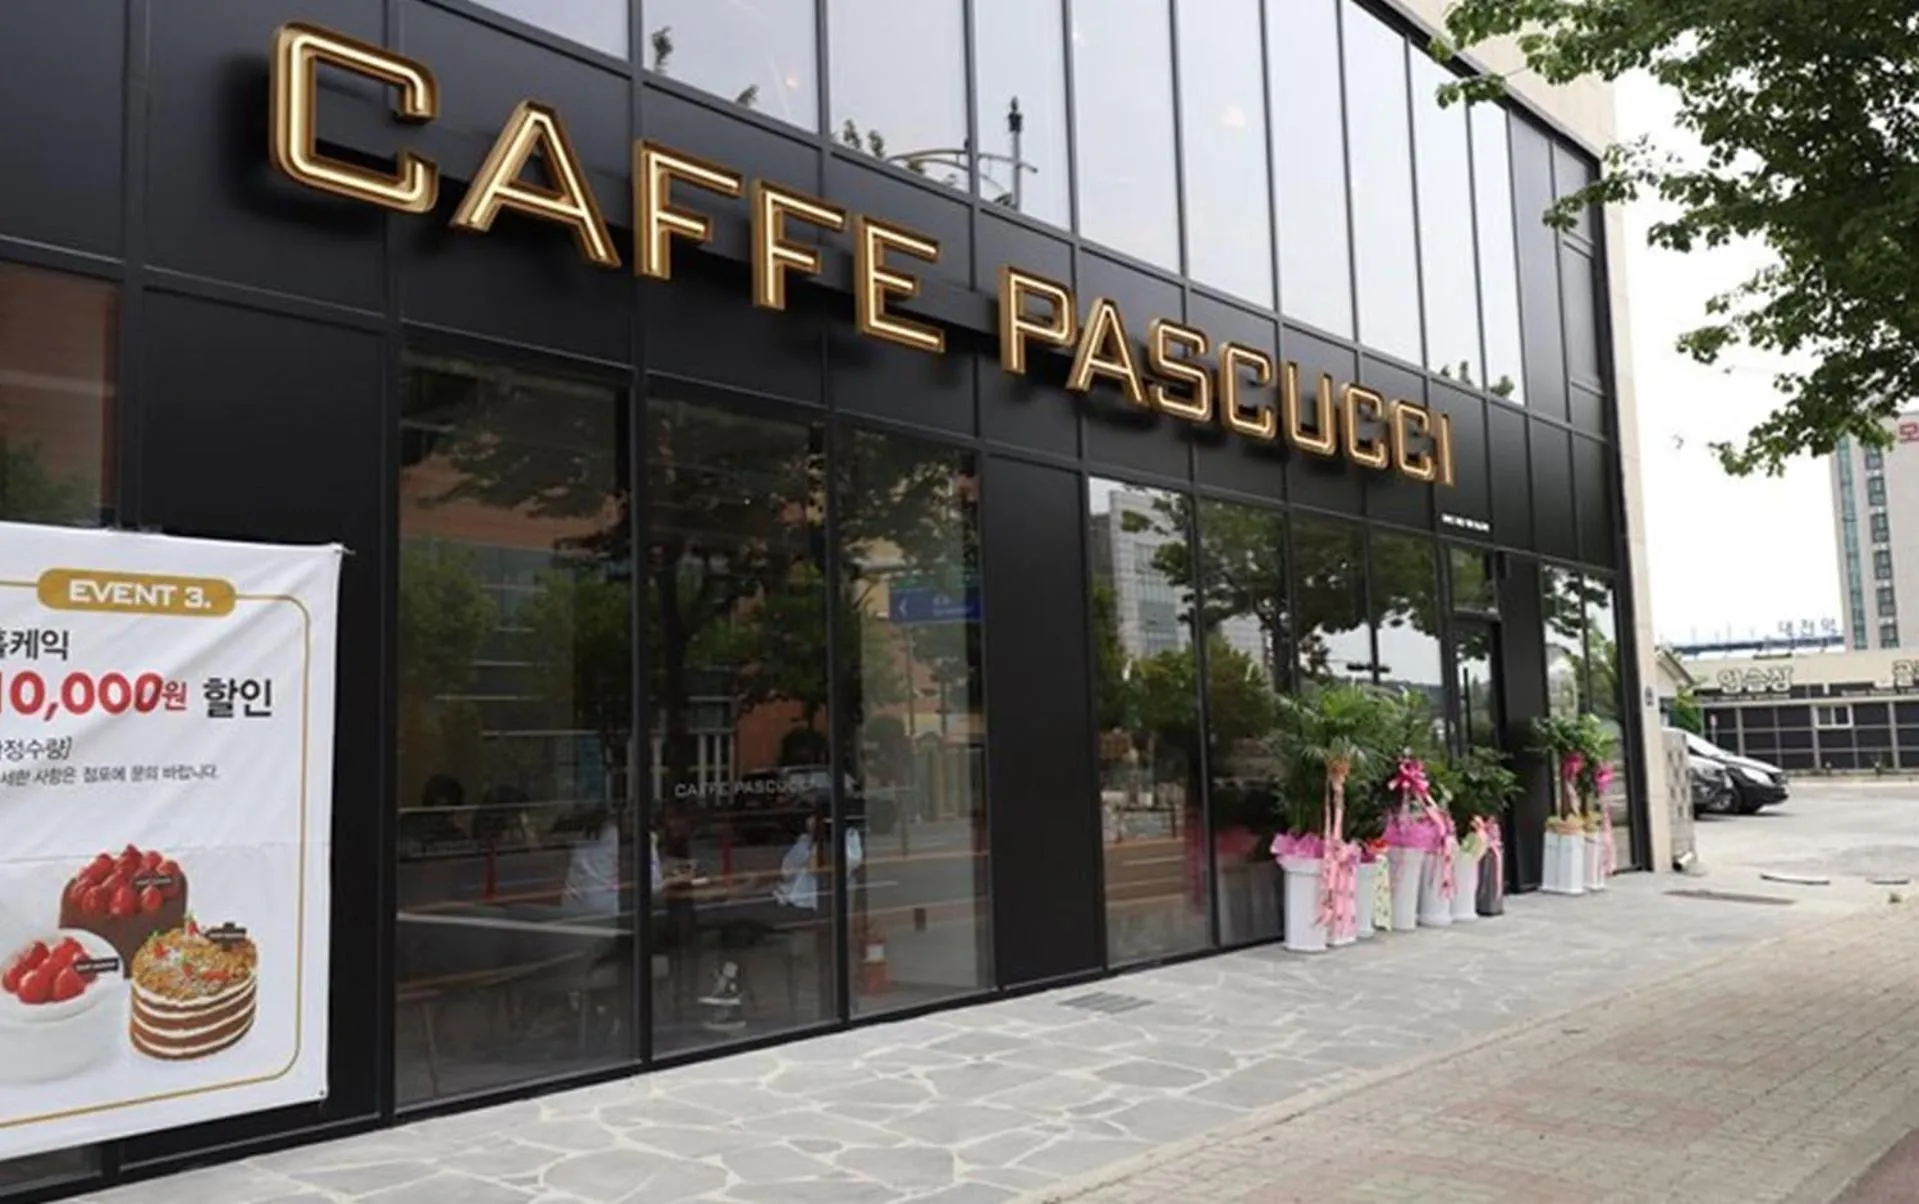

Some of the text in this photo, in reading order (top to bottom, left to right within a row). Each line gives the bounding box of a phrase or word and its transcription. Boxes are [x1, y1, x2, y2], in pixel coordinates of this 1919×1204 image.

[269, 22, 1455, 488] CAFFE PASCUCCI
[69, 579, 212, 609] EVENT 3.
[0, 671, 272, 722] 0,000원 할인
[0, 736, 73, 761] 정수량]
